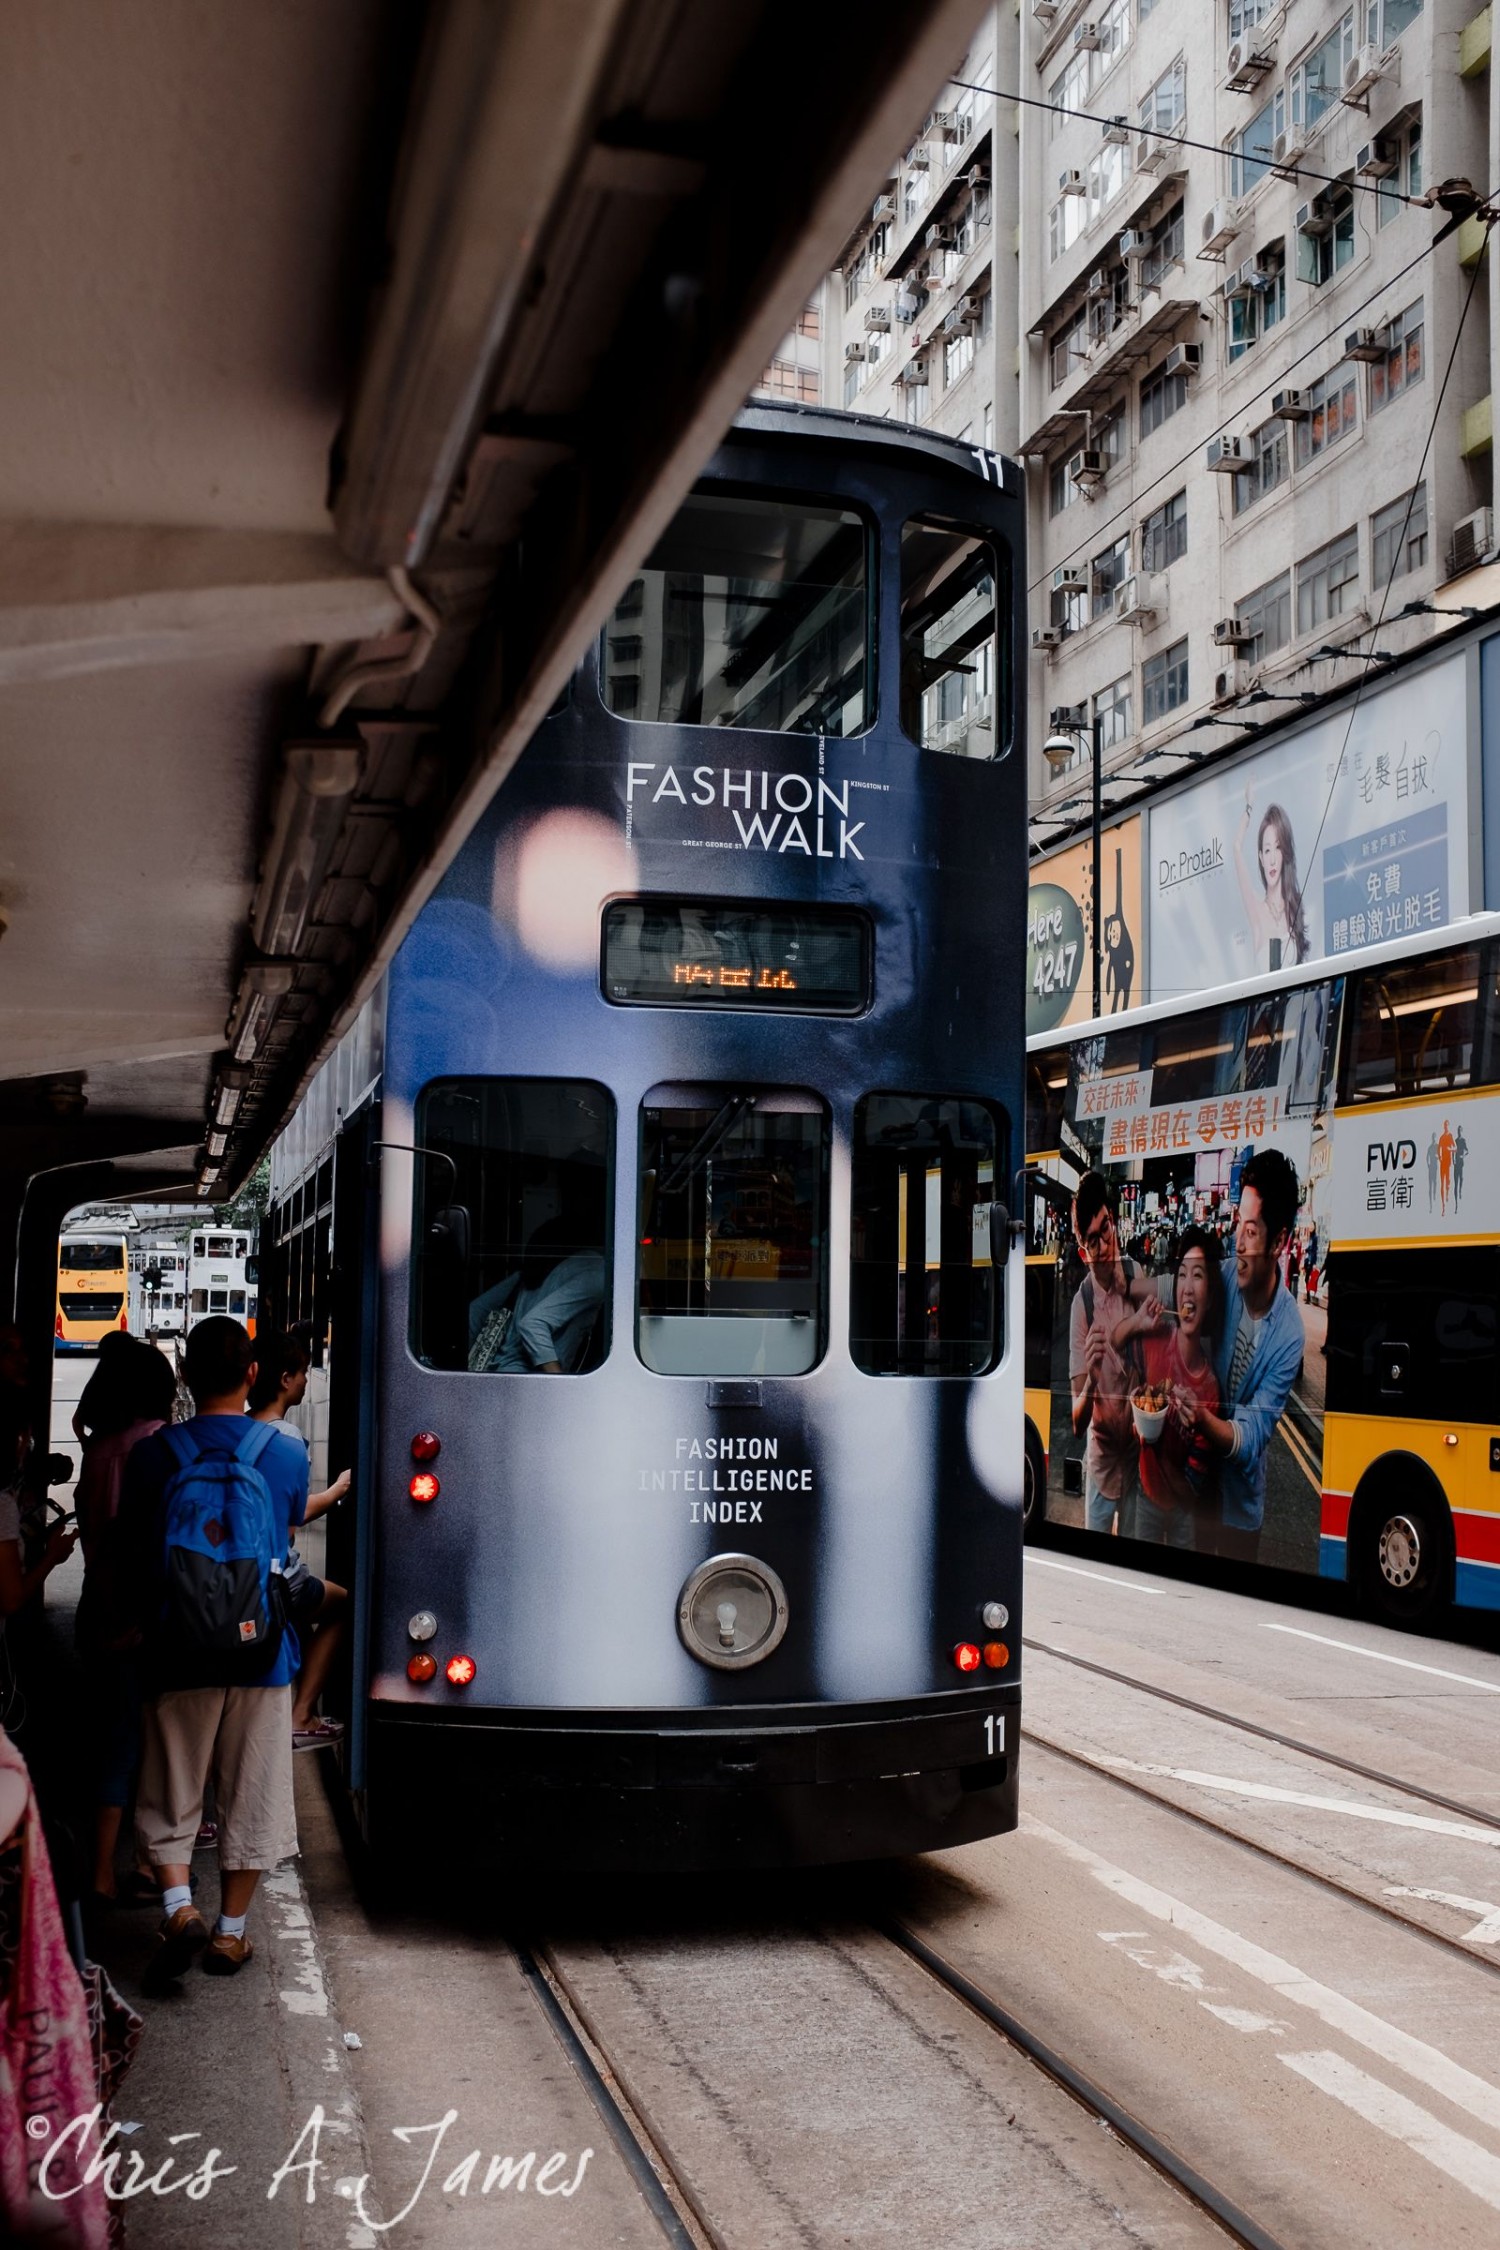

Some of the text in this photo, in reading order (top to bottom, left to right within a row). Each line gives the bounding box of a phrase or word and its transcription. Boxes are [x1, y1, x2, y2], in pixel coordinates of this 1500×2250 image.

[971, 447, 1004, 489] 11
[626, 762, 849, 818] FASHION
[850, 780, 890, 792] KINGSTON ST
[625, 804, 633, 839] PATERSON
[731, 809, 866, 861] WALK
[681, 839, 703, 847] GREAT
[704, 841, 733, 850] GEORGE
[1159, 859, 1177, 886] Dr.
[1179, 837, 1223, 878] Protalk
[1366, 863, 1402, 905] 免費
[1027, 907, 1063, 947] Here
[1033, 944, 1078, 997] 4247
[1367, 1139, 1417, 1173] FWD
[1366, 1175, 1415, 1212] 富衛
[675, 1437, 778, 1460] FASHION
[638, 1469, 813, 1492] INTELLIGENCE
[689, 1501, 763, 1524] INDEX
[983, 1714, 1006, 1755] 11
